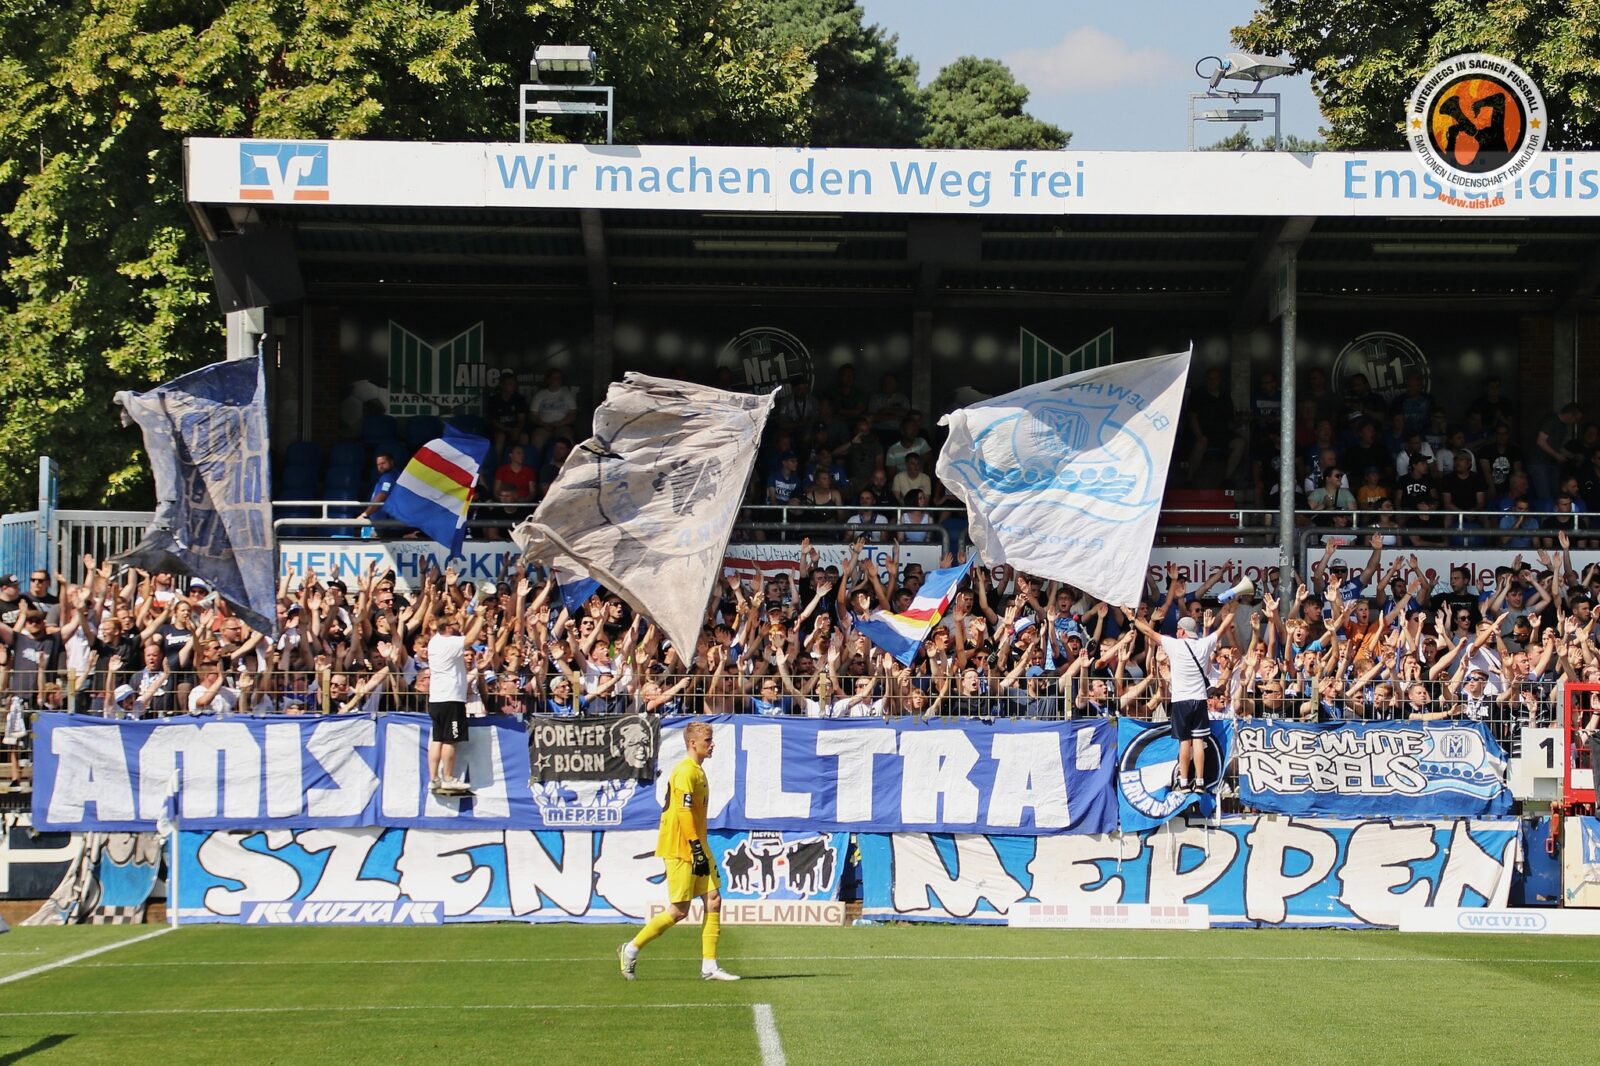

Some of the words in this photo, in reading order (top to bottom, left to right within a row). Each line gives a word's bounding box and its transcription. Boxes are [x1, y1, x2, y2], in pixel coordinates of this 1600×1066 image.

[496, 154, 577, 191] Wir
[595, 156, 771, 194] machen
[789, 158, 872, 195] den
[890, 161, 991, 208] Weg
[1010, 160, 1084, 197] frei
[743, 352, 788, 386] Nr.1
[281, 552, 385, 577] HEINZ
[533, 724, 606, 749] FOREVER
[1238, 727, 1318, 754] BLUE
[1318, 729, 1427, 756] WHITE
[554, 749, 605, 773] BJÖRN
[1539, 737, 1554, 769] 1
[45, 718, 511, 824] AMISIA
[1239, 751, 1428, 794] REBELS
[198, 829, 670, 918] SZENE
[294, 902, 395, 923] KUZKA
[1467, 911, 1538, 929] wavin
